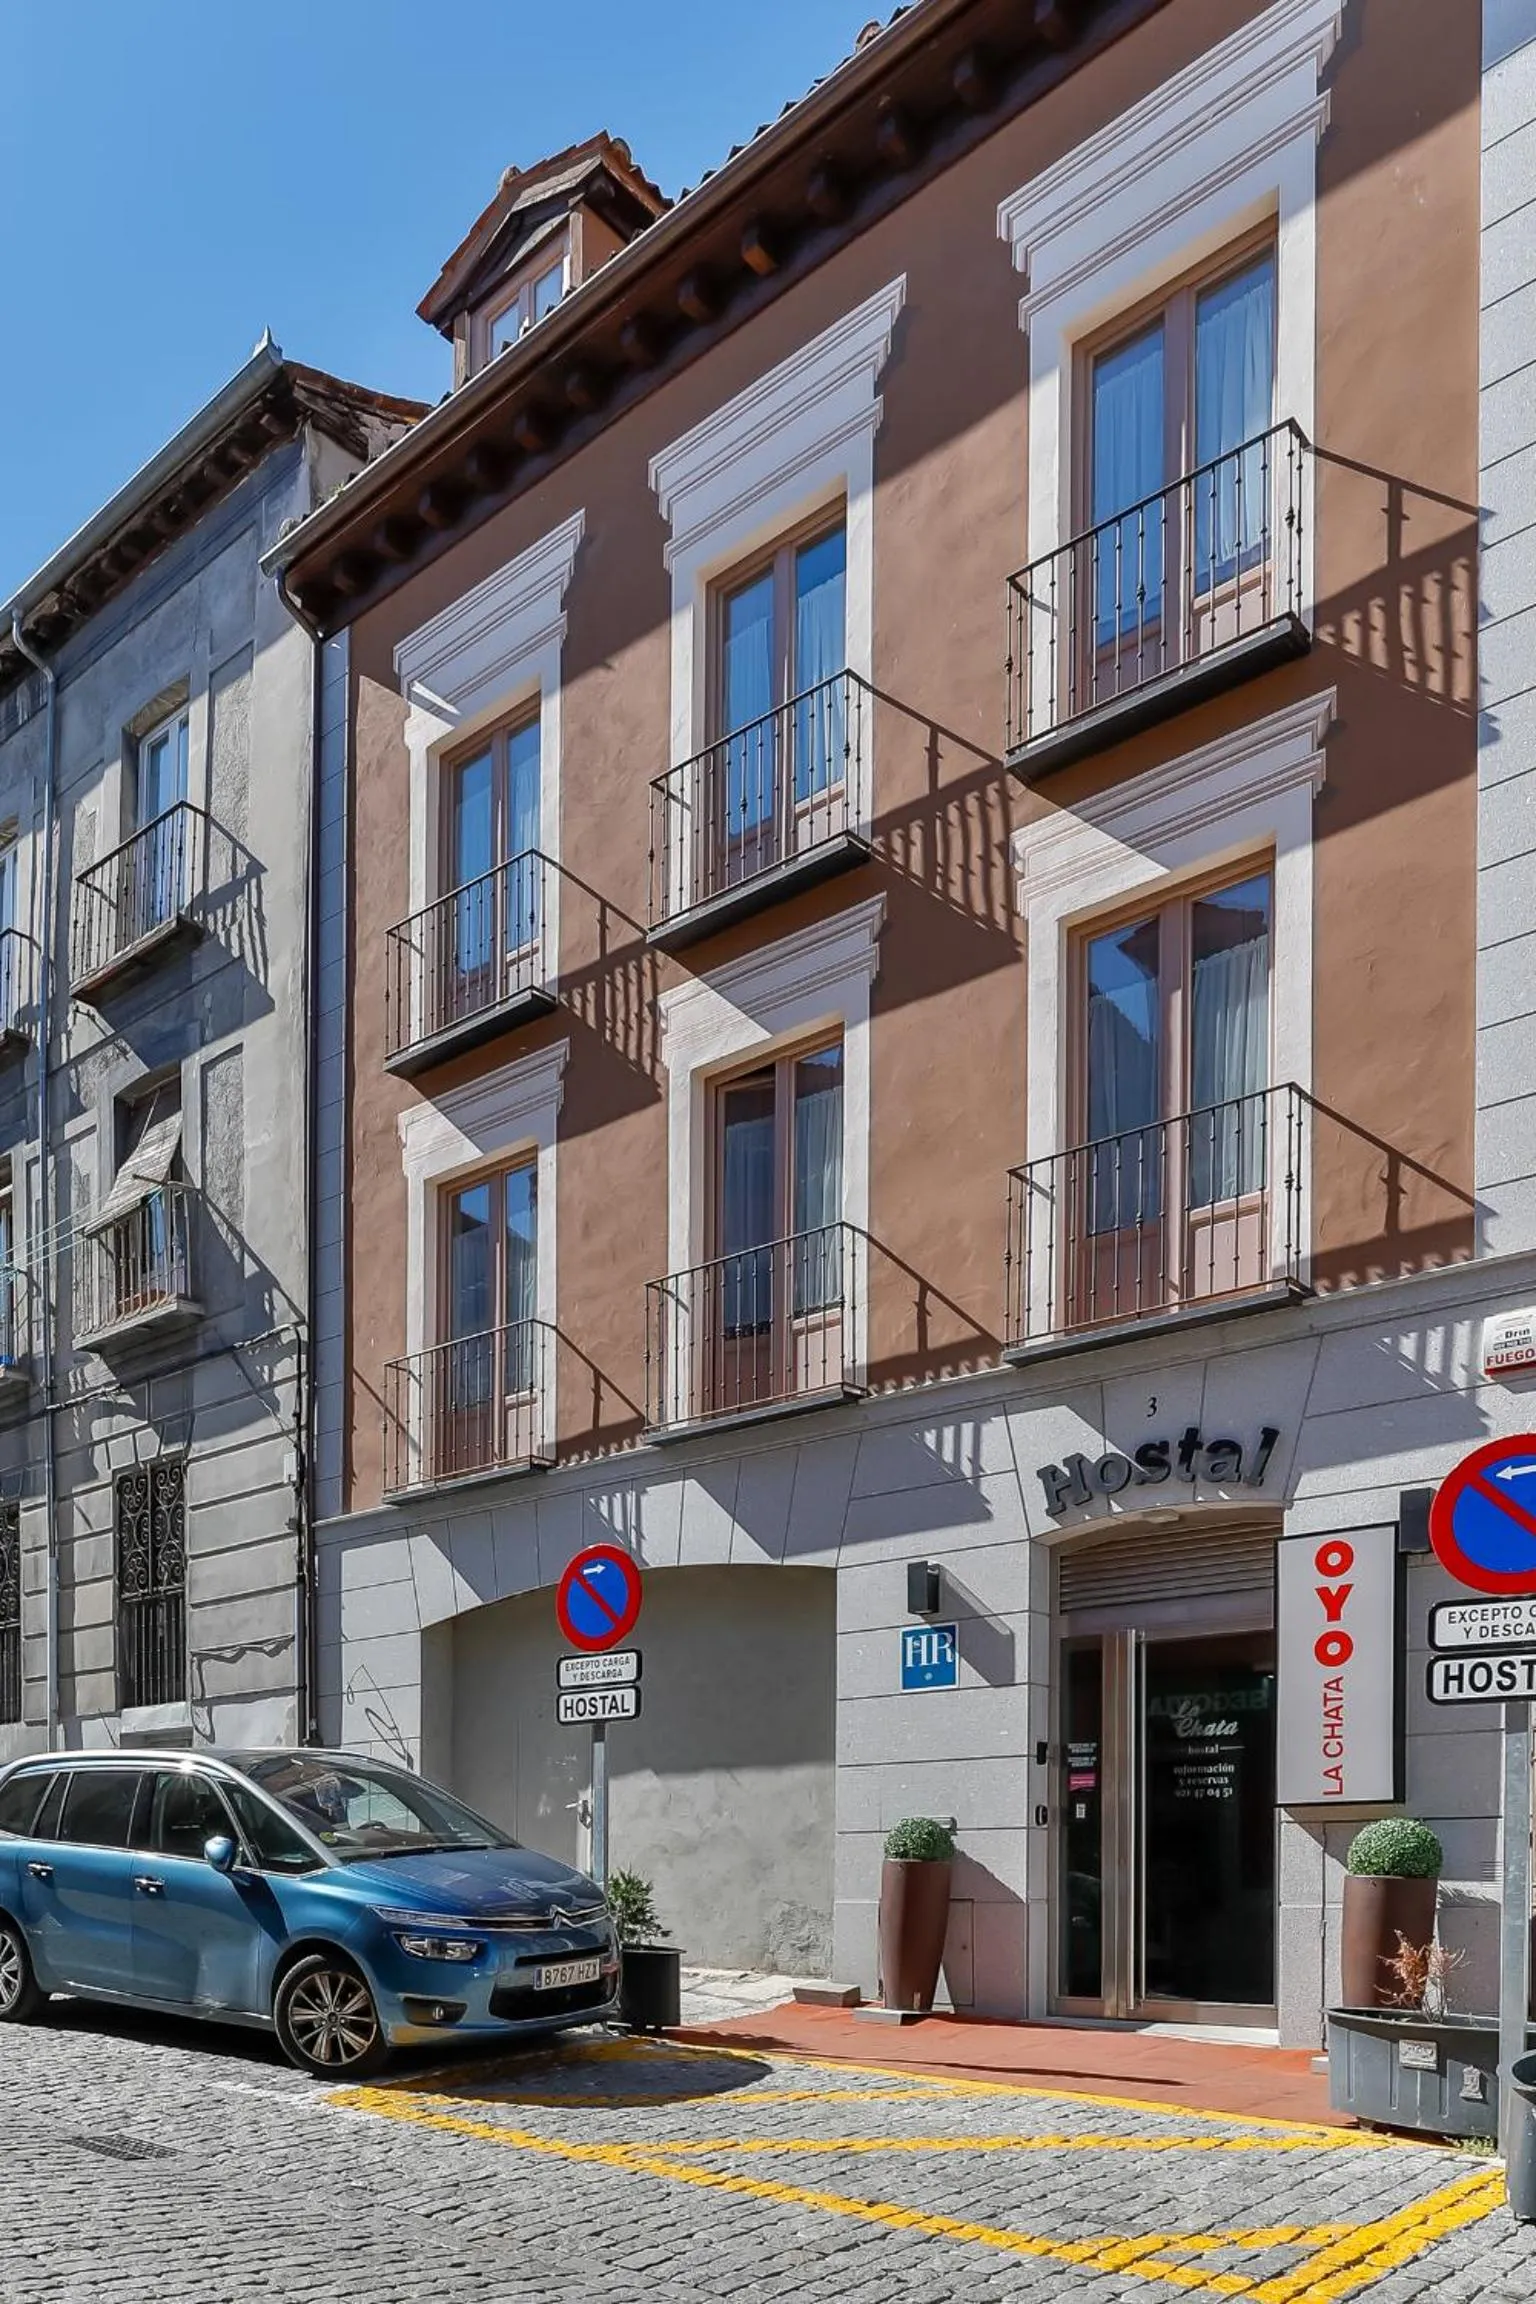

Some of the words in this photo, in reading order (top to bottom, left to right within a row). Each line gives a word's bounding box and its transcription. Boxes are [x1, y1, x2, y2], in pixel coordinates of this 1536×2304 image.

[1486, 1347, 1536, 1366] FUEGO
[1146, 1397, 1158, 1418] 3
[1037, 1426, 1280, 1516] Hostal
[1314, 1540, 1354, 1668] OYO
[1447, 1606, 1523, 1624] EXCEPTO
[1463, 1626, 1473, 1640] Y
[1479, 1622, 1535, 1638] DESCA
[564, 1659, 600, 1672] EXCEPTO
[602, 1655, 631, 1668] CARGA
[572, 1671, 578, 1682] Y
[580, 1668, 623, 1681] DESCARGA
[1443, 1660, 1536, 1695] HOST
[564, 1694, 630, 1719] HOSTAL
[1323, 1675, 1345, 1758] CHATA
[1174, 1717, 1239, 1738] Chata
[1322, 1763, 1344, 1796] LA
[544, 1966, 575, 1986] 8767
